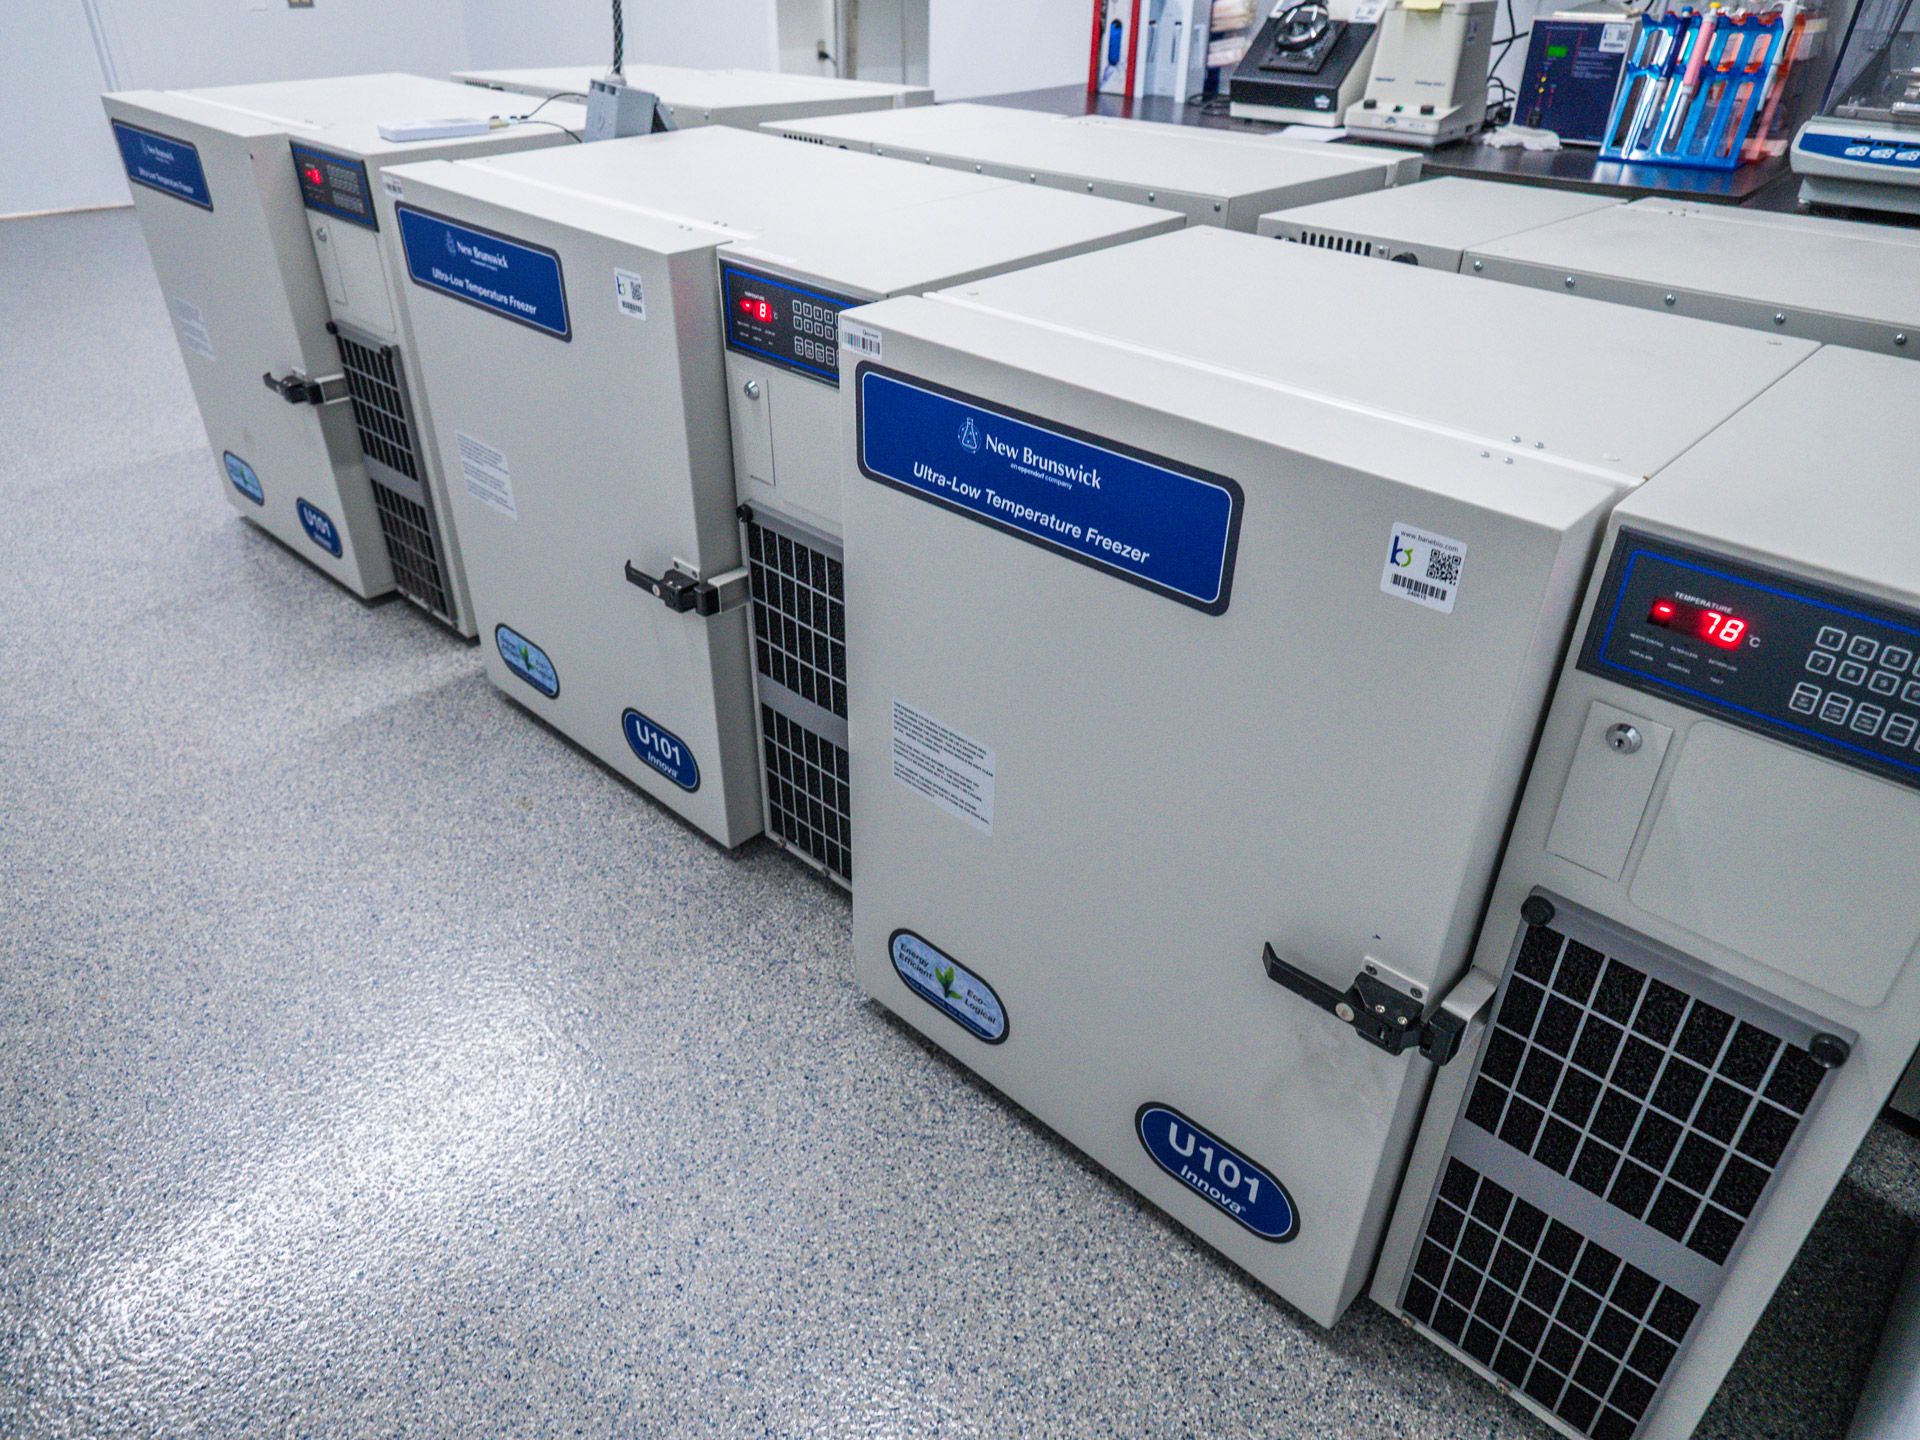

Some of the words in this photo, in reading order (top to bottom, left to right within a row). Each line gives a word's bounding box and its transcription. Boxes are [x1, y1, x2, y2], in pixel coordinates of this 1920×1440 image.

[457, 241, 472, 257] New
[473, 246, 509, 269] Brunswick
[432, 267, 464, 288] Ultra-Low
[465, 279, 508, 304] Temperature
[510, 295, 537, 315] Freezer
[985, 433, 1019, 461] New
[1022, 446, 1102, 490] Brunswick
[1017, 465, 1045, 480] eppendorf
[1044, 474, 1073, 491] company
[913, 461, 981, 500] Ultra-Low
[986, 489, 1082, 539] Temperature
[1085, 527, 1151, 564] Freezer
[1675, 591, 1733, 615] TEMPERATURE
[635, 719, 681, 767] U101
[898, 952, 932, 980] Efficient
[900, 943, 930, 968] Energy
[964, 998, 996, 1025] Logical
[966, 988, 987, 1007] Eco-
[1168, 1120, 1260, 1205] U101
